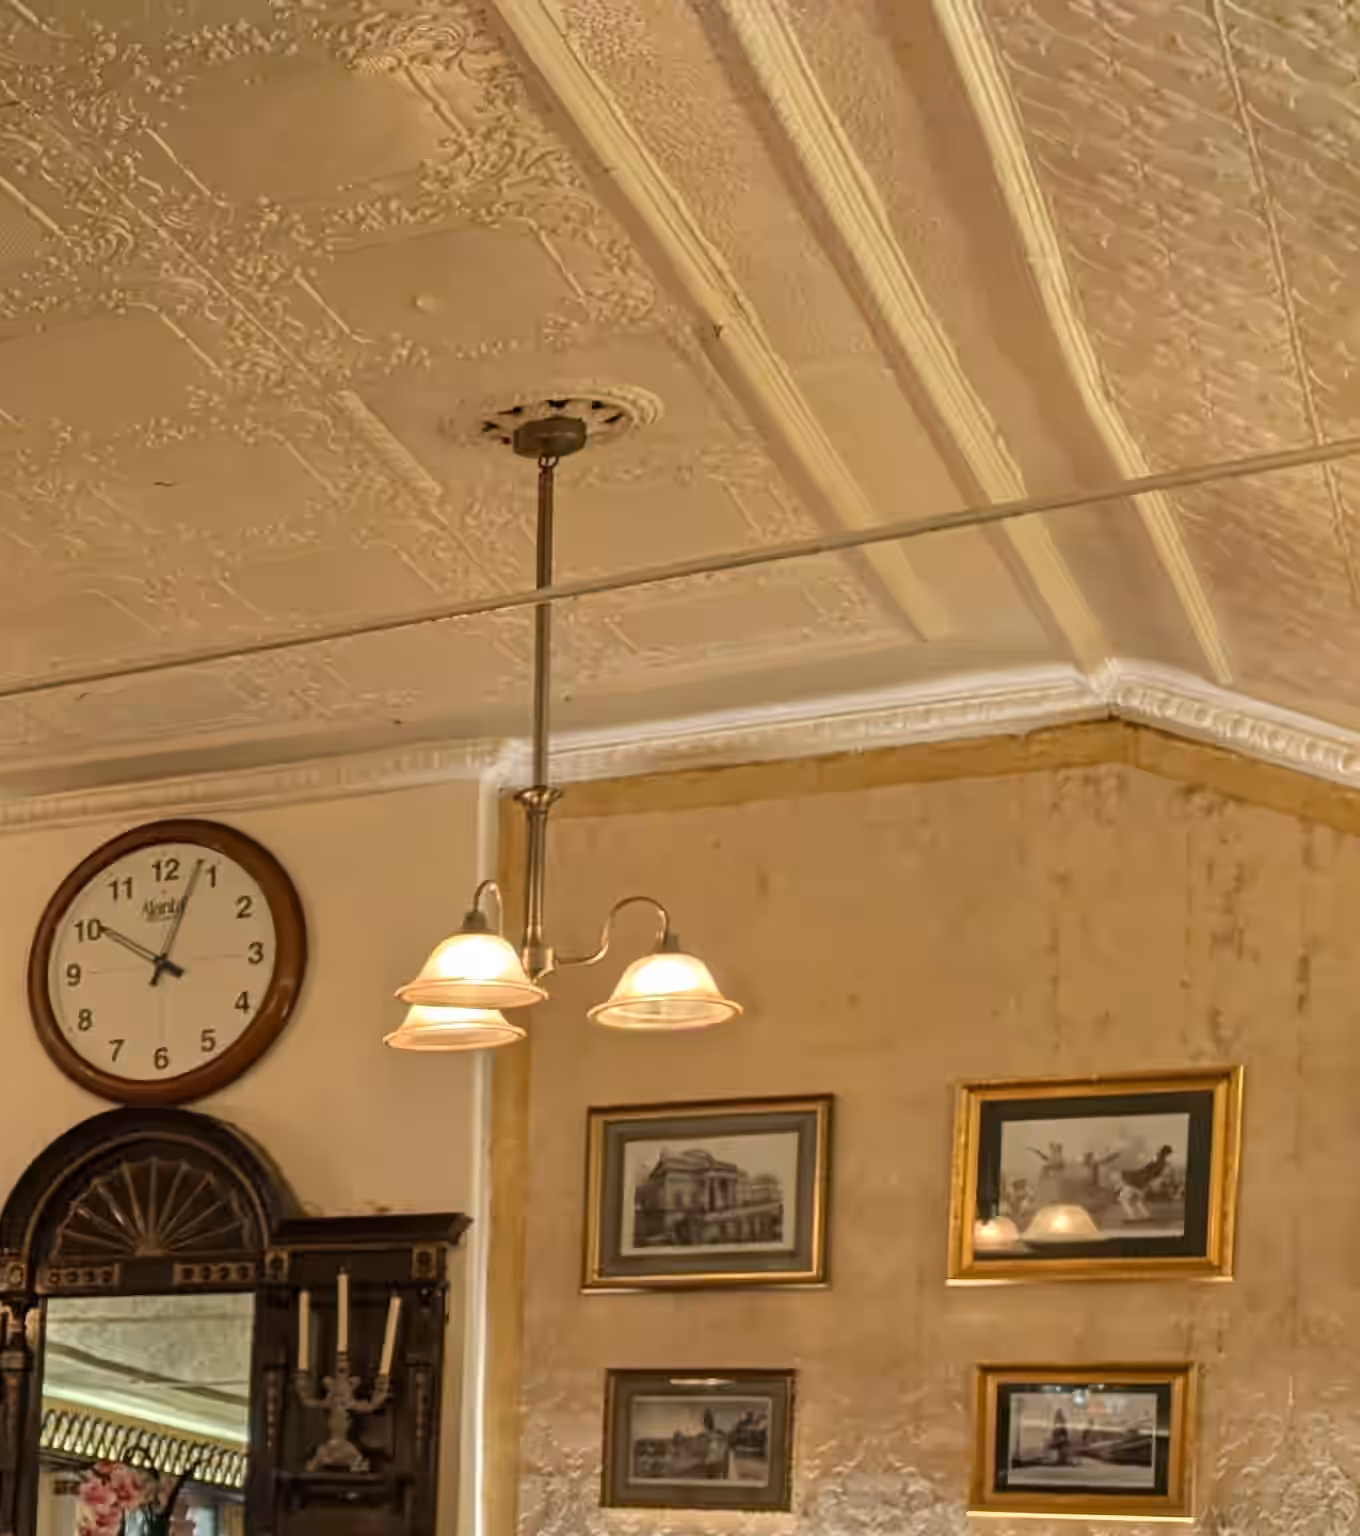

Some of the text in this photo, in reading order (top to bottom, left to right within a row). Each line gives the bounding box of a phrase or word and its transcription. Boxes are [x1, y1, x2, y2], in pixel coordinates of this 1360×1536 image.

[152, 858, 181, 882] 12
[206, 864, 218, 889] 1
[108, 876, 134, 902] 11
[235, 895, 253, 920] 2
[74, 918, 102, 943] 10
[247, 941, 265, 966] 3
[66, 963, 82, 987] 9
[234, 990, 251, 1014] 4
[77, 1008, 93, 1032] 8
[108, 1038, 125, 1063] 7
[200, 1028, 217, 1053] 5
[153, 1046, 170, 1071] 6
